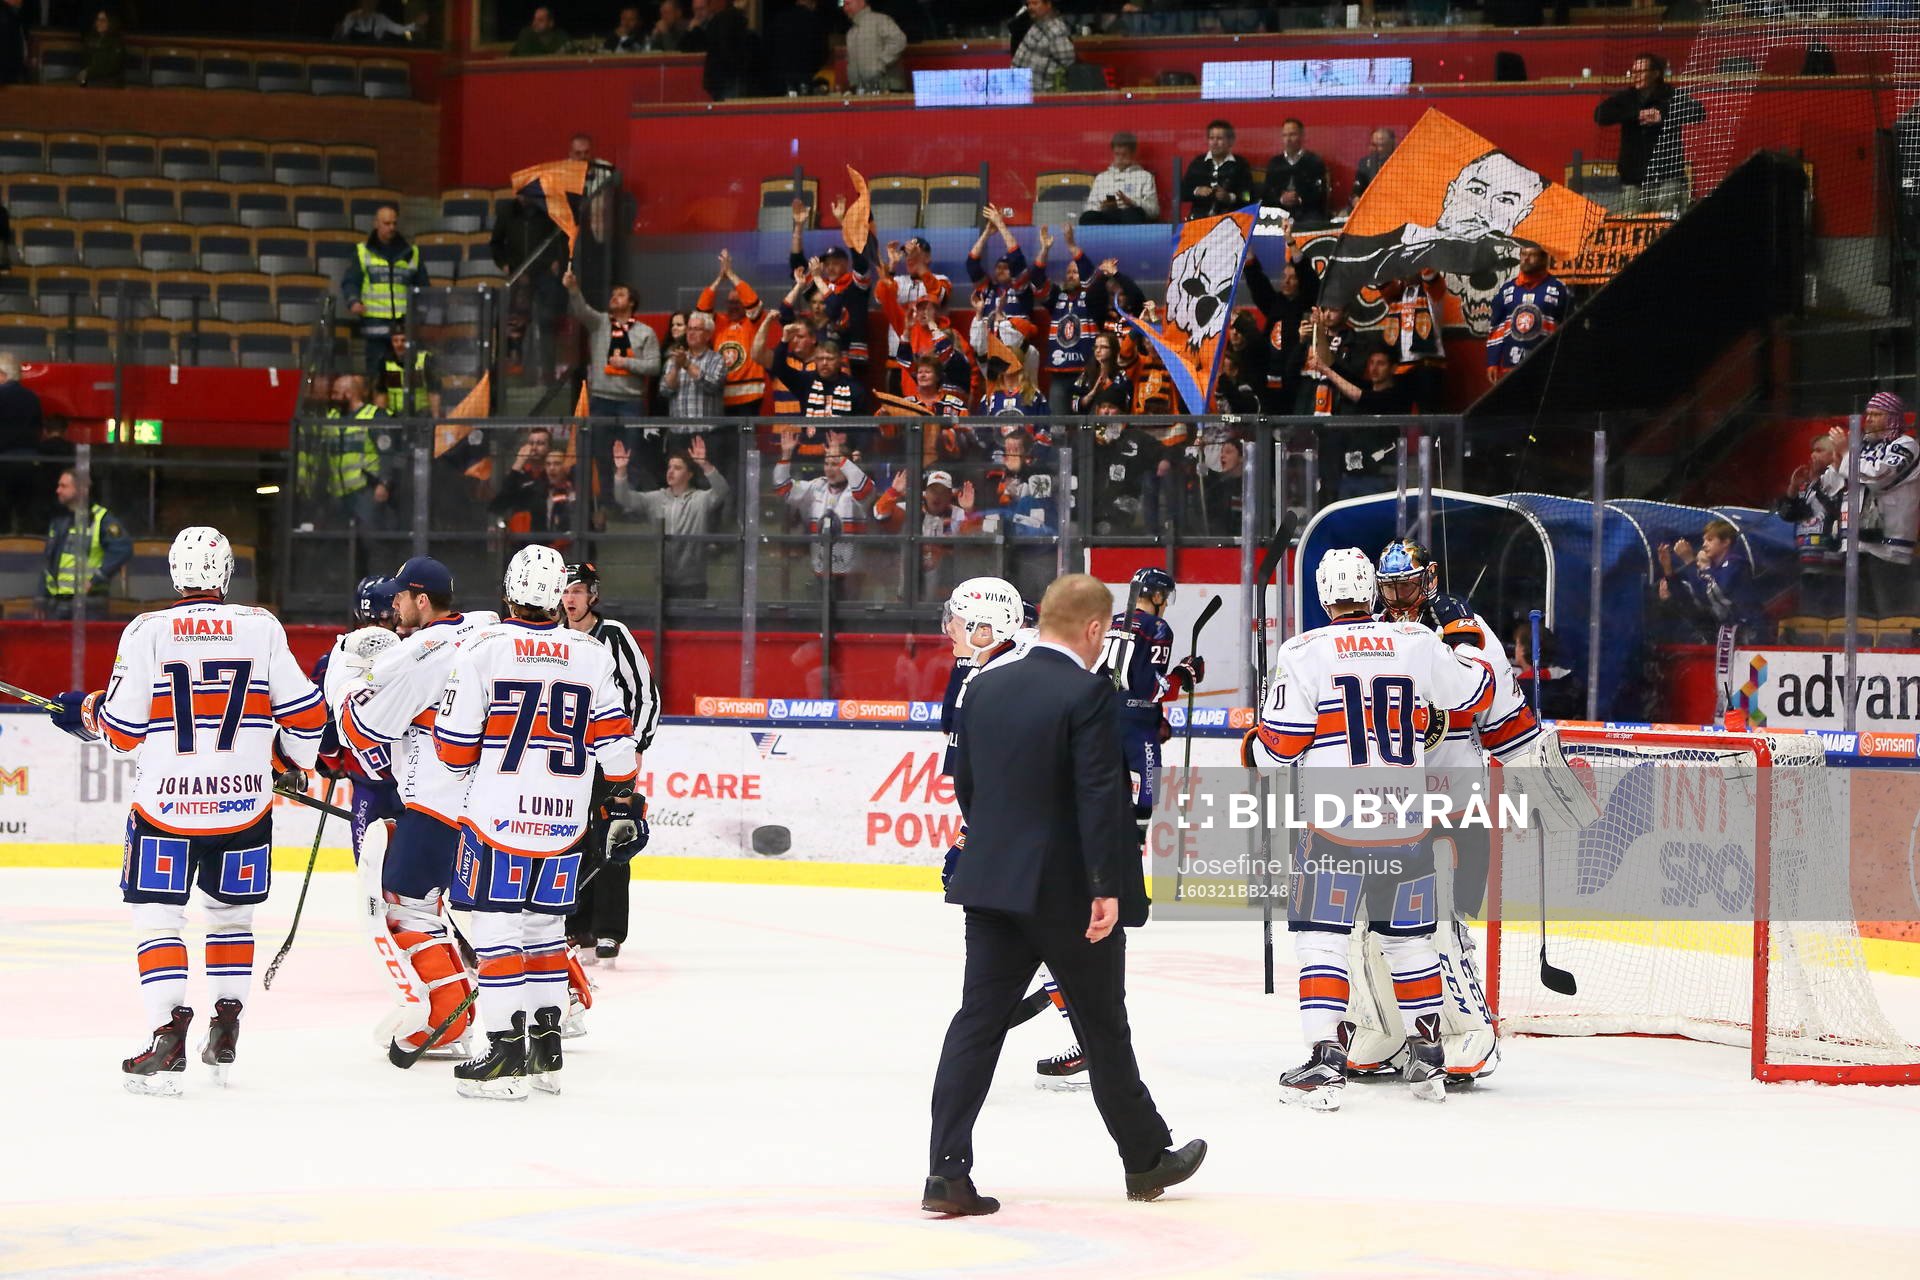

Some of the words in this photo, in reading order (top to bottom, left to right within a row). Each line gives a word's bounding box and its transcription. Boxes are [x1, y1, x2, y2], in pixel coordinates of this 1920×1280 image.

[184, 562, 193, 570] 17
[537, 582, 547, 592] 79
[361, 599, 371, 609] 12
[985, 592, 1012, 605] VISMA
[173, 617, 233, 635] MAXI
[456, 624, 475, 635] CCM
[514, 639, 569, 660] MAXI
[1334, 635, 1394, 653] MAXI
[526, 656, 569, 667] STORMARKNAD
[1151, 645, 1170, 665] 29
[1349, 651, 1396, 659] STORMARKNAD
[107, 675, 123, 702] 7
[160, 658, 254, 755] 17
[717, 701, 765, 714] SYNSAM
[789, 701, 834, 717] MAPEI
[859, 704, 906, 717] SYNSAM
[490, 678, 594, 779] 79
[1331, 673, 1416, 768] 10
[1823, 733, 1858, 753] MAPEI
[1875, 738, 1914, 753] SYNSAM
[156, 774, 263, 796] JOHANSSON
[666, 772, 761, 800] CARE
[175, 798, 256, 815] INTERSPORT
[518, 795, 573, 818] LUNDH
[510, 820, 579, 838] INTERSPORT
[460, 849, 472, 883] ALWEX
[374, 936, 421, 1003] CCM
[1438, 951, 1472, 1016] CCM
[1459, 958, 1492, 1026] CCM
